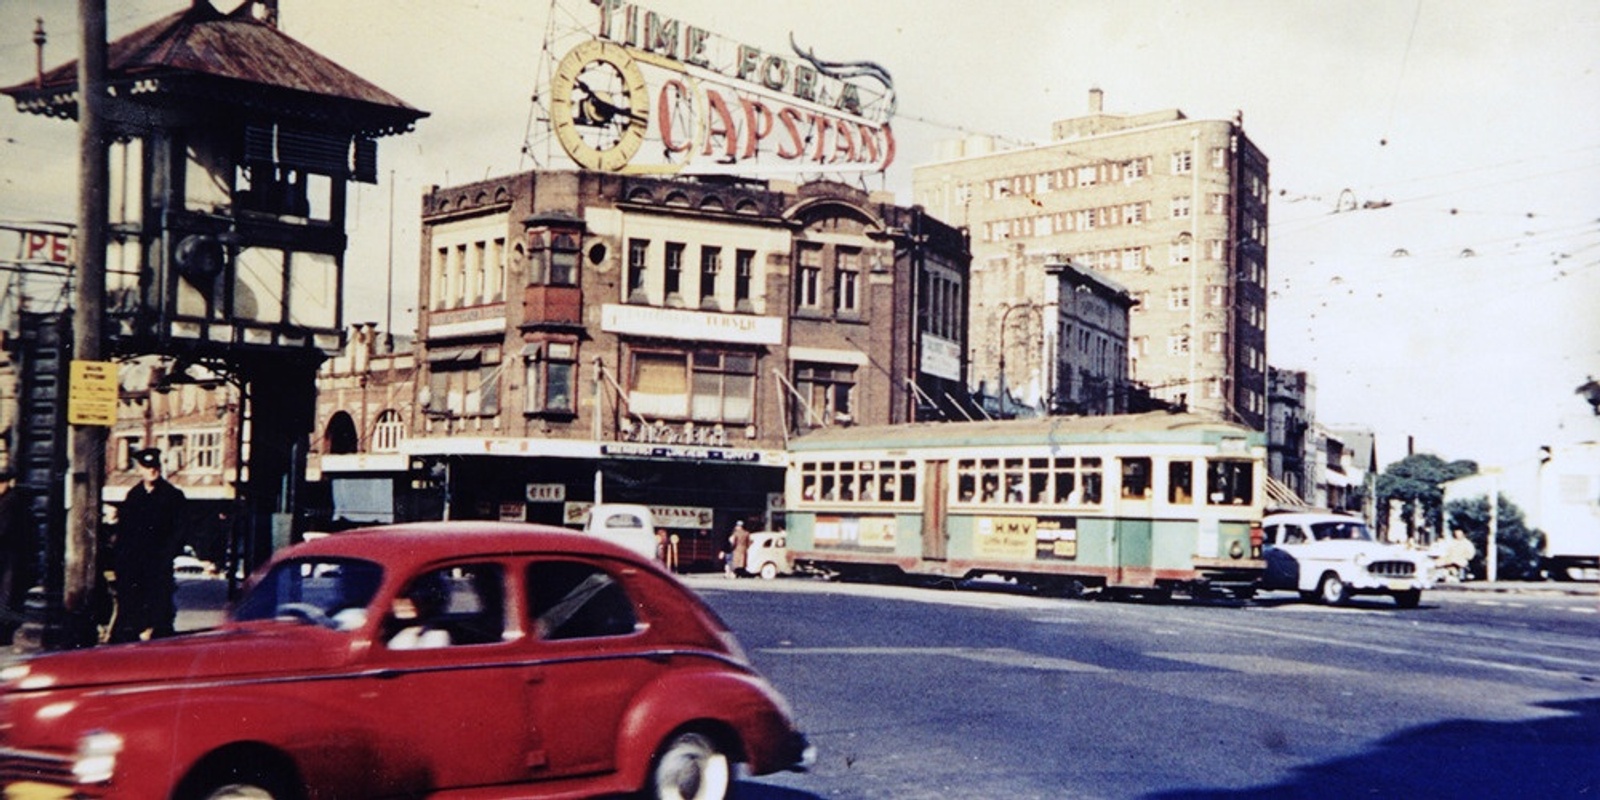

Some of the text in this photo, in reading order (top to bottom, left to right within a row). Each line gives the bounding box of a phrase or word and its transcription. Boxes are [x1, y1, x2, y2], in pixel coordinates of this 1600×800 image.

[590, 0, 863, 117] TIME FOR A
[658, 79, 895, 172] CAPSTAN
[529, 487, 562, 499] CAFE
[650, 508, 697, 517] STEAKS
